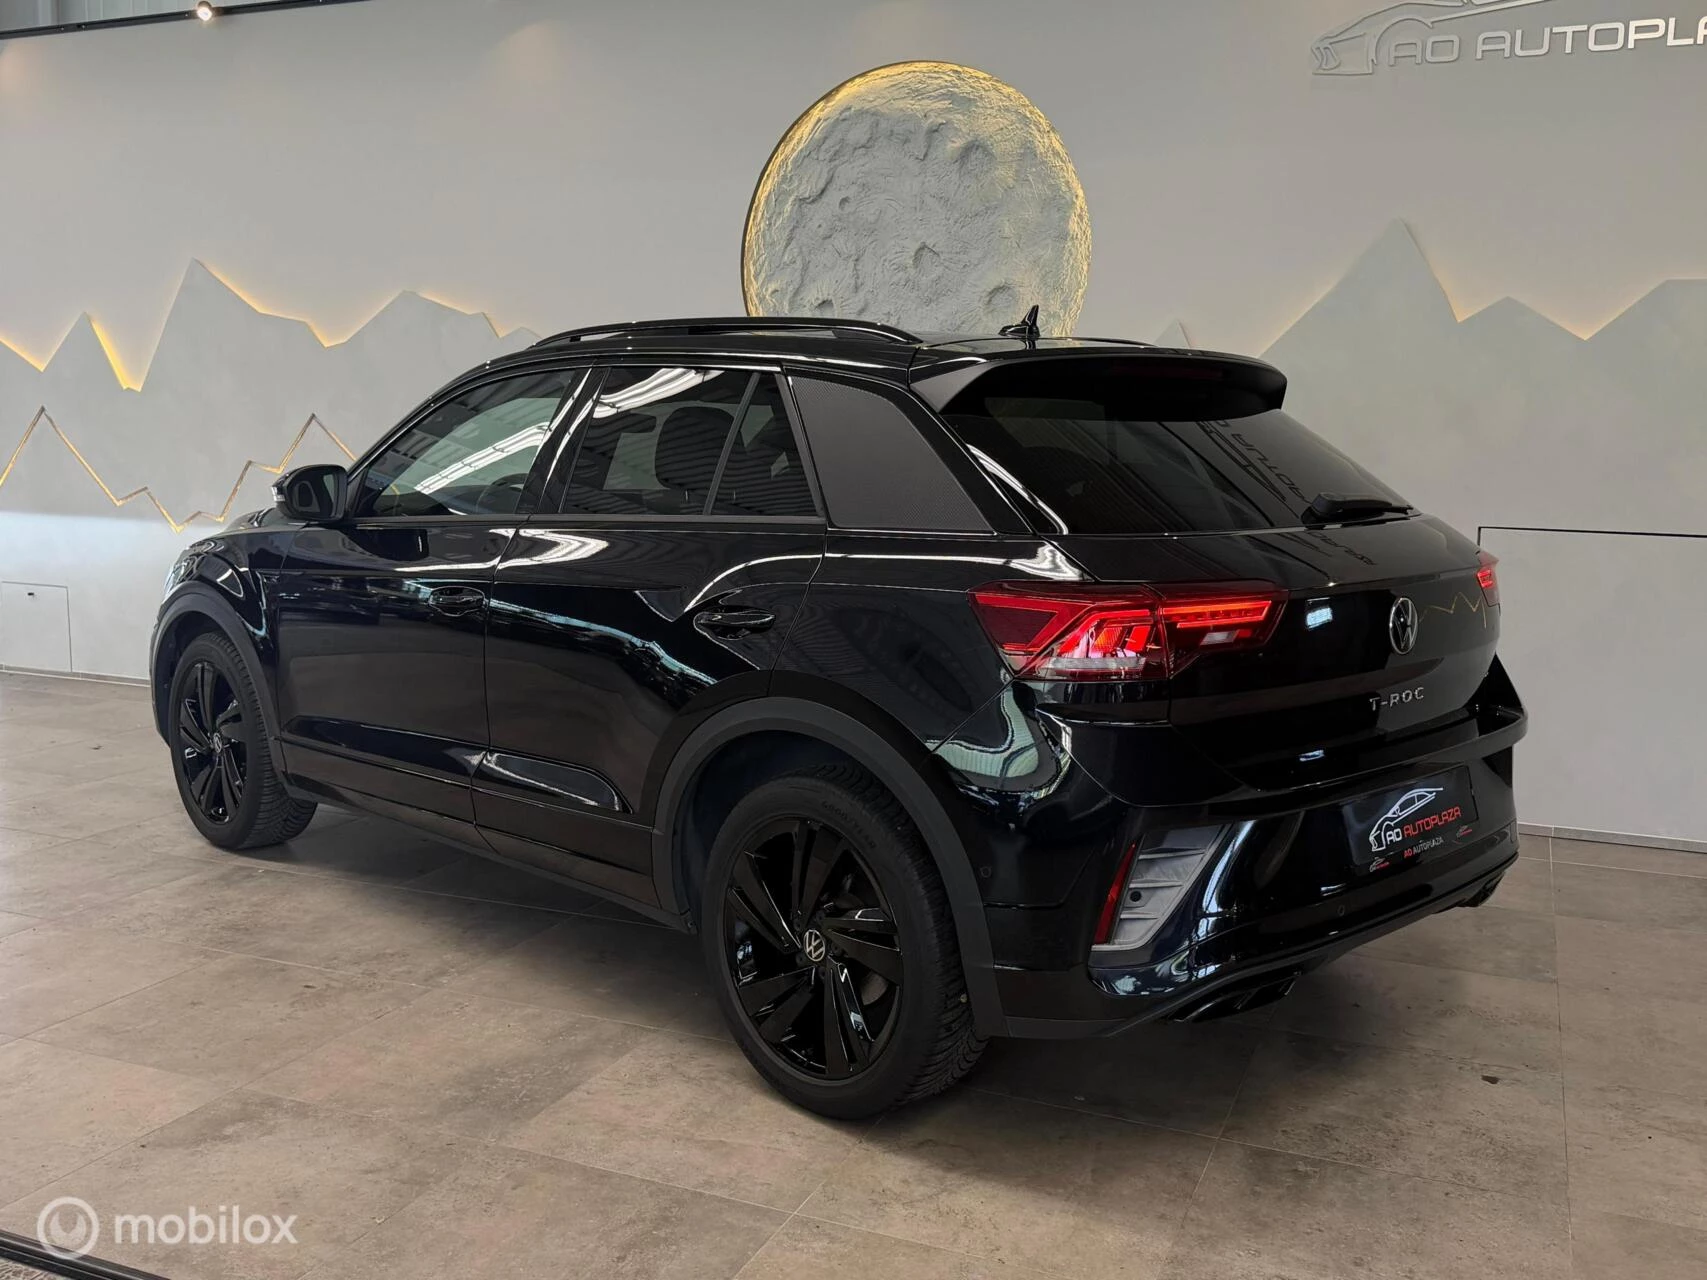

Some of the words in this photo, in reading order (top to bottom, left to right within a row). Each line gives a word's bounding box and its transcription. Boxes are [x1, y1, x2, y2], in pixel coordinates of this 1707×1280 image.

[1388, 35, 1460, 66] AO
[1369, 687, 1424, 711] T-ROC
[1403, 806, 1462, 838] AUTOPLAZA
[1413, 837, 1444, 855] AUTOPLAZA
